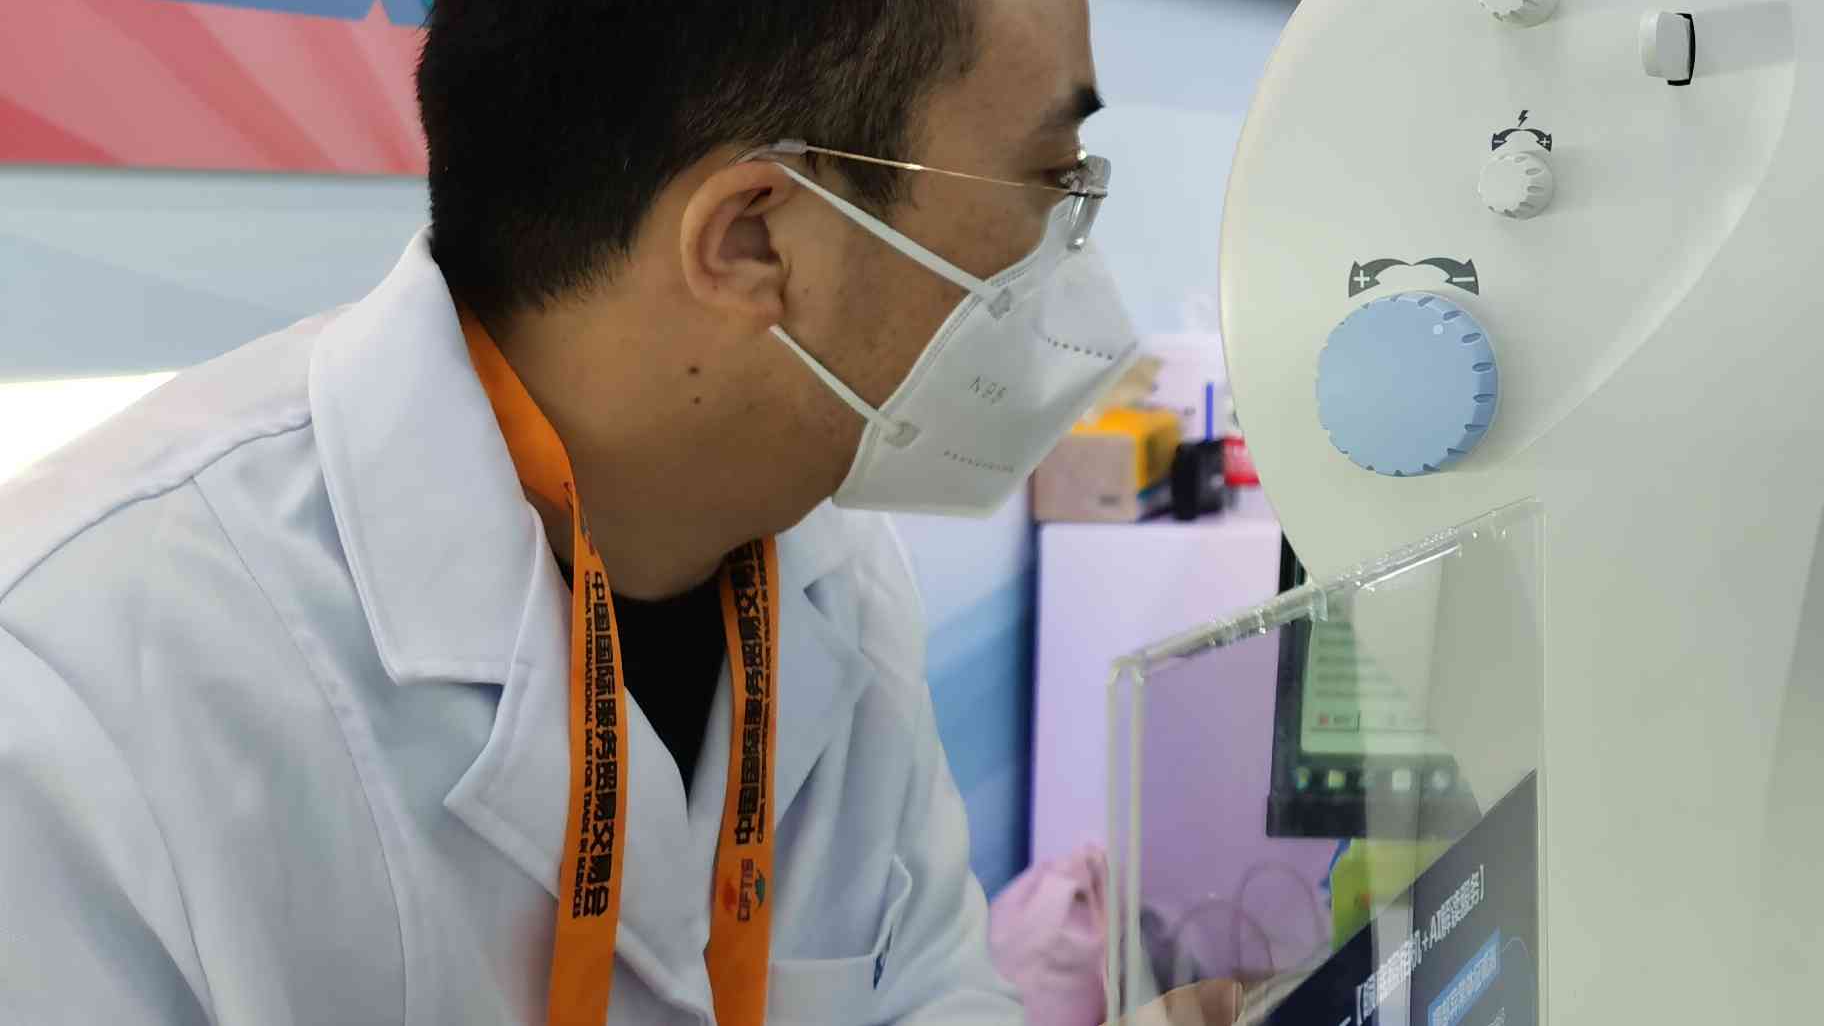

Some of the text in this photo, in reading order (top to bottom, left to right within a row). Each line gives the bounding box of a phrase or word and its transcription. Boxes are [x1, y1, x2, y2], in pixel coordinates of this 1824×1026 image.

[583, 571, 618, 917] 中国国际服务贸易交易会
